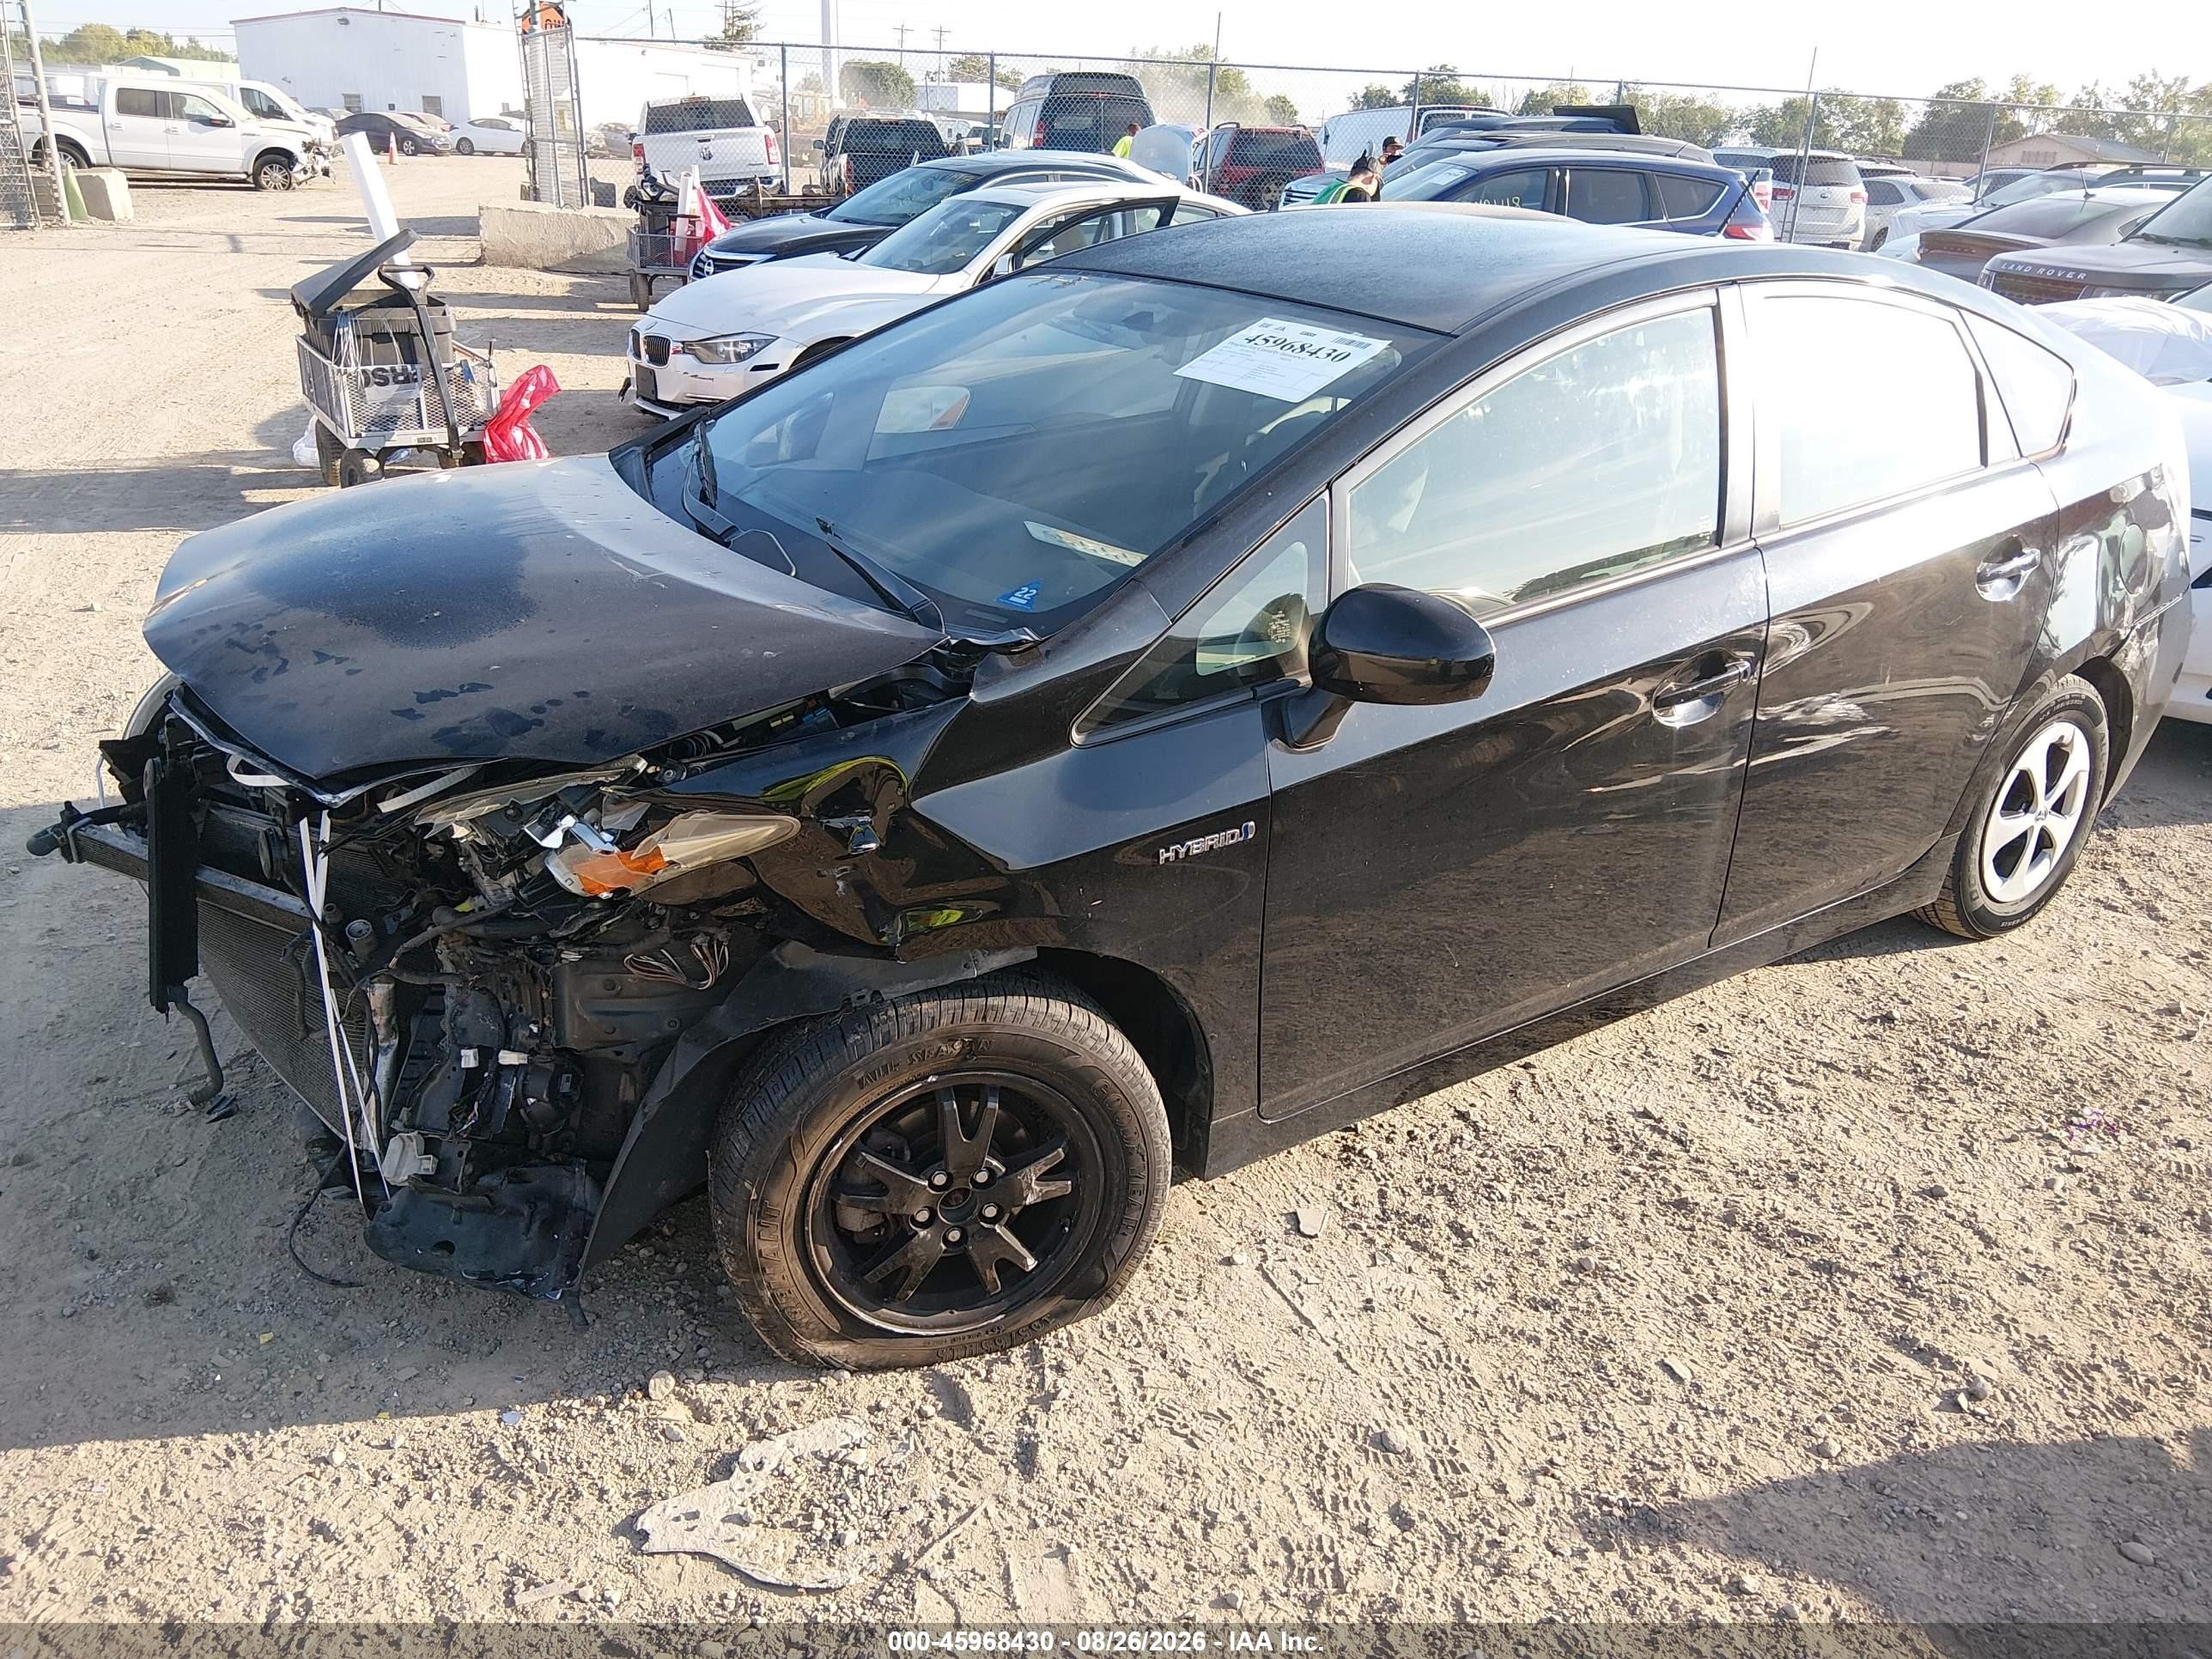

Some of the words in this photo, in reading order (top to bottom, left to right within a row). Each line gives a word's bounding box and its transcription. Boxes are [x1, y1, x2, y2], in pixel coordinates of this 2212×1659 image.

[2001, 262, 2033, 273] LAND
[2037, 267, 2087, 280] ROVER
[1244, 333, 1352, 363] 45968430
[1014, 586, 1037, 600] 22
[1158, 828, 1241, 866] HYBRID
[1090, 1079, 1146, 1237] GOODYEAR
